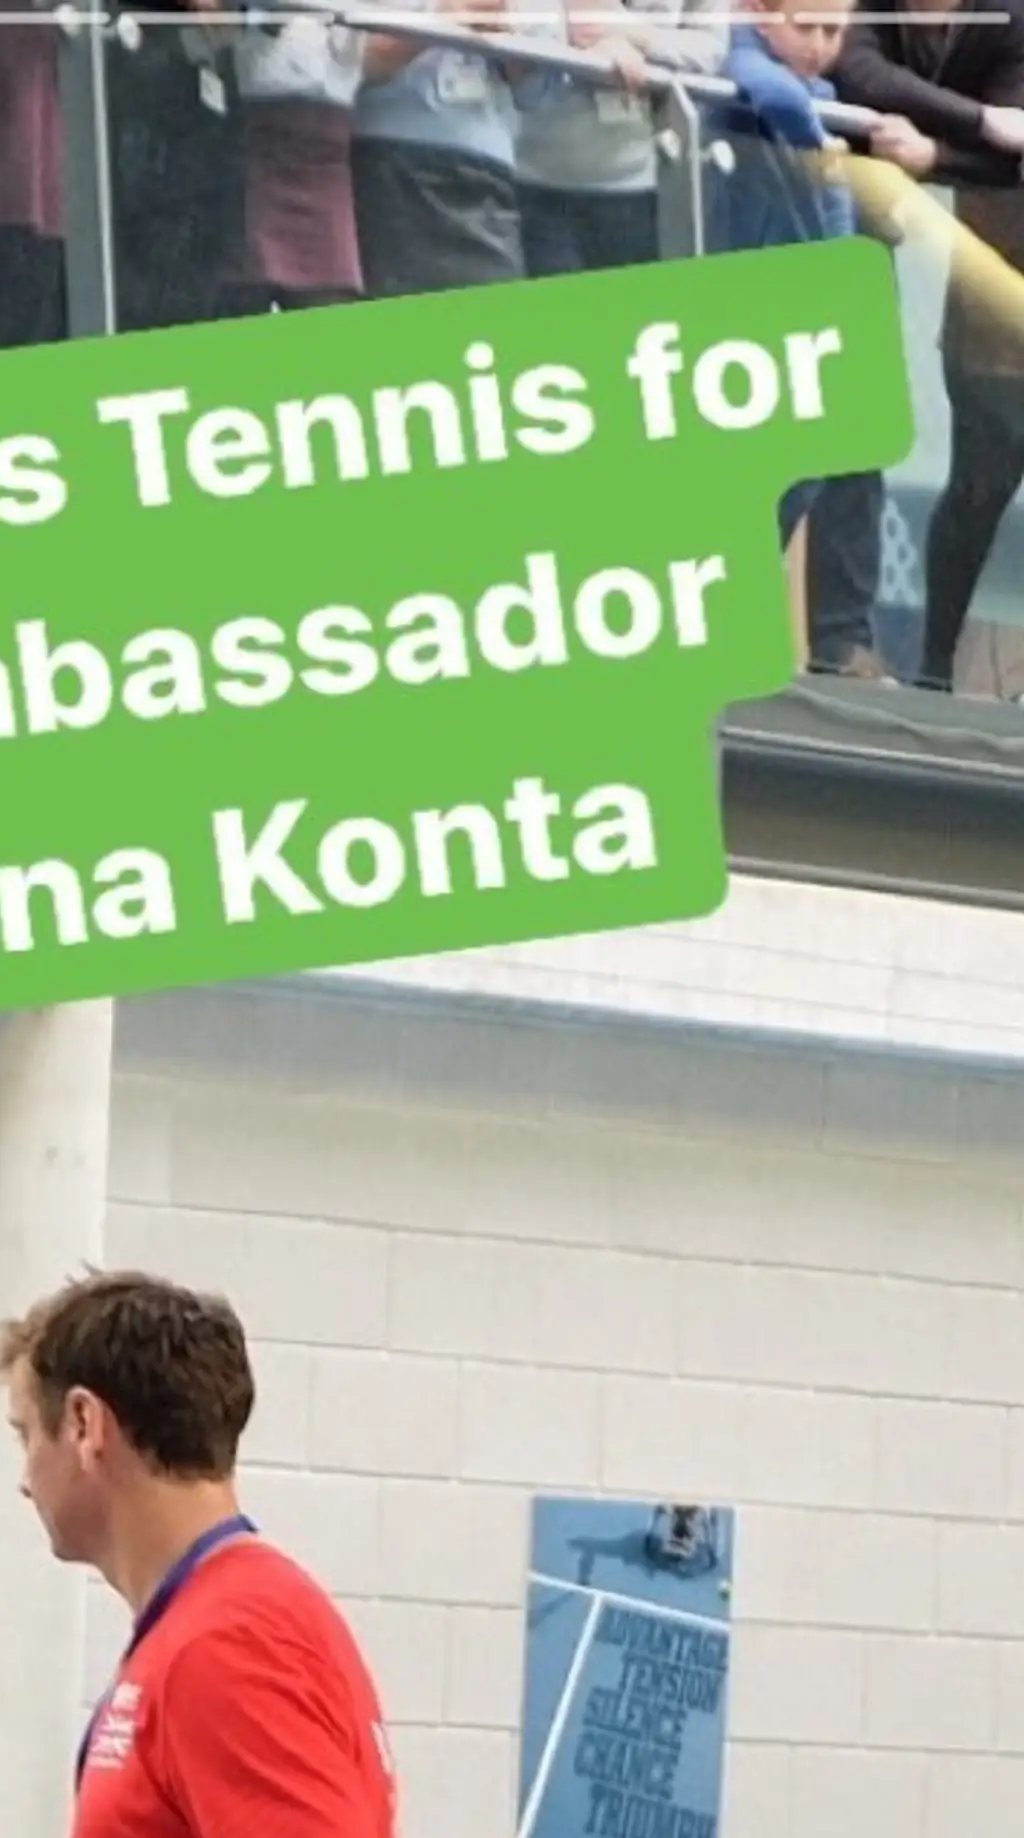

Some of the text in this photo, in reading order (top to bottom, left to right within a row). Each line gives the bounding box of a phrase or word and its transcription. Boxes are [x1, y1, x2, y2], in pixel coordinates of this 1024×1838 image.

[619, 1652, 722, 1714] TENSION
[582, 1686, 687, 1751] SILENCE
[574, 1729, 680, 1800] CHANCE
